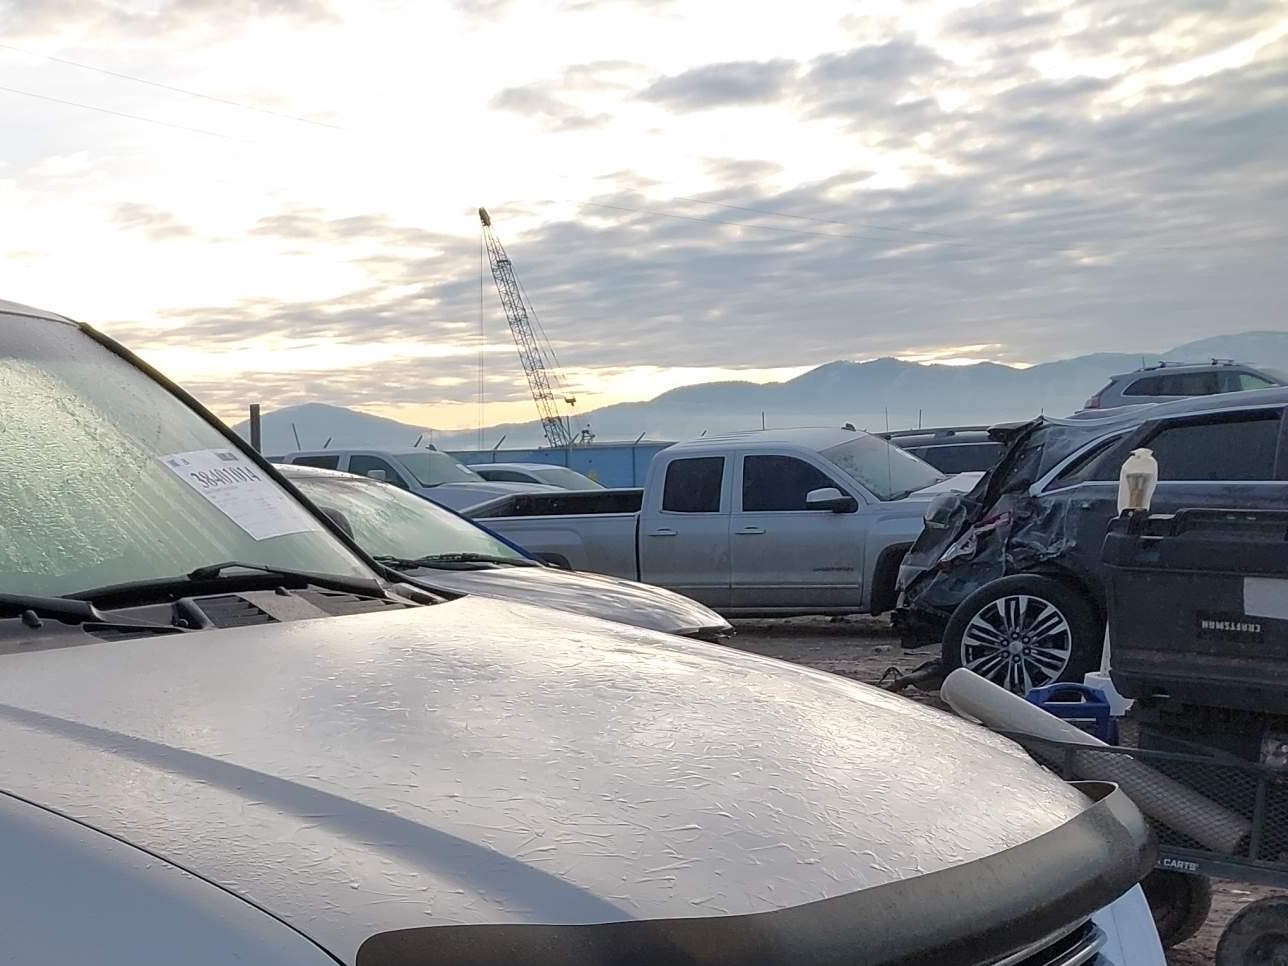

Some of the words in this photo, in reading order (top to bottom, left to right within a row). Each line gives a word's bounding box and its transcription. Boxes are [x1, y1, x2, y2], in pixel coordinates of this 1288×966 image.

[190, 466, 262, 489] 38401014
[1201, 620, 1261, 633] CRAFTSMAN
[1163, 858, 1197, 871] CARTS
